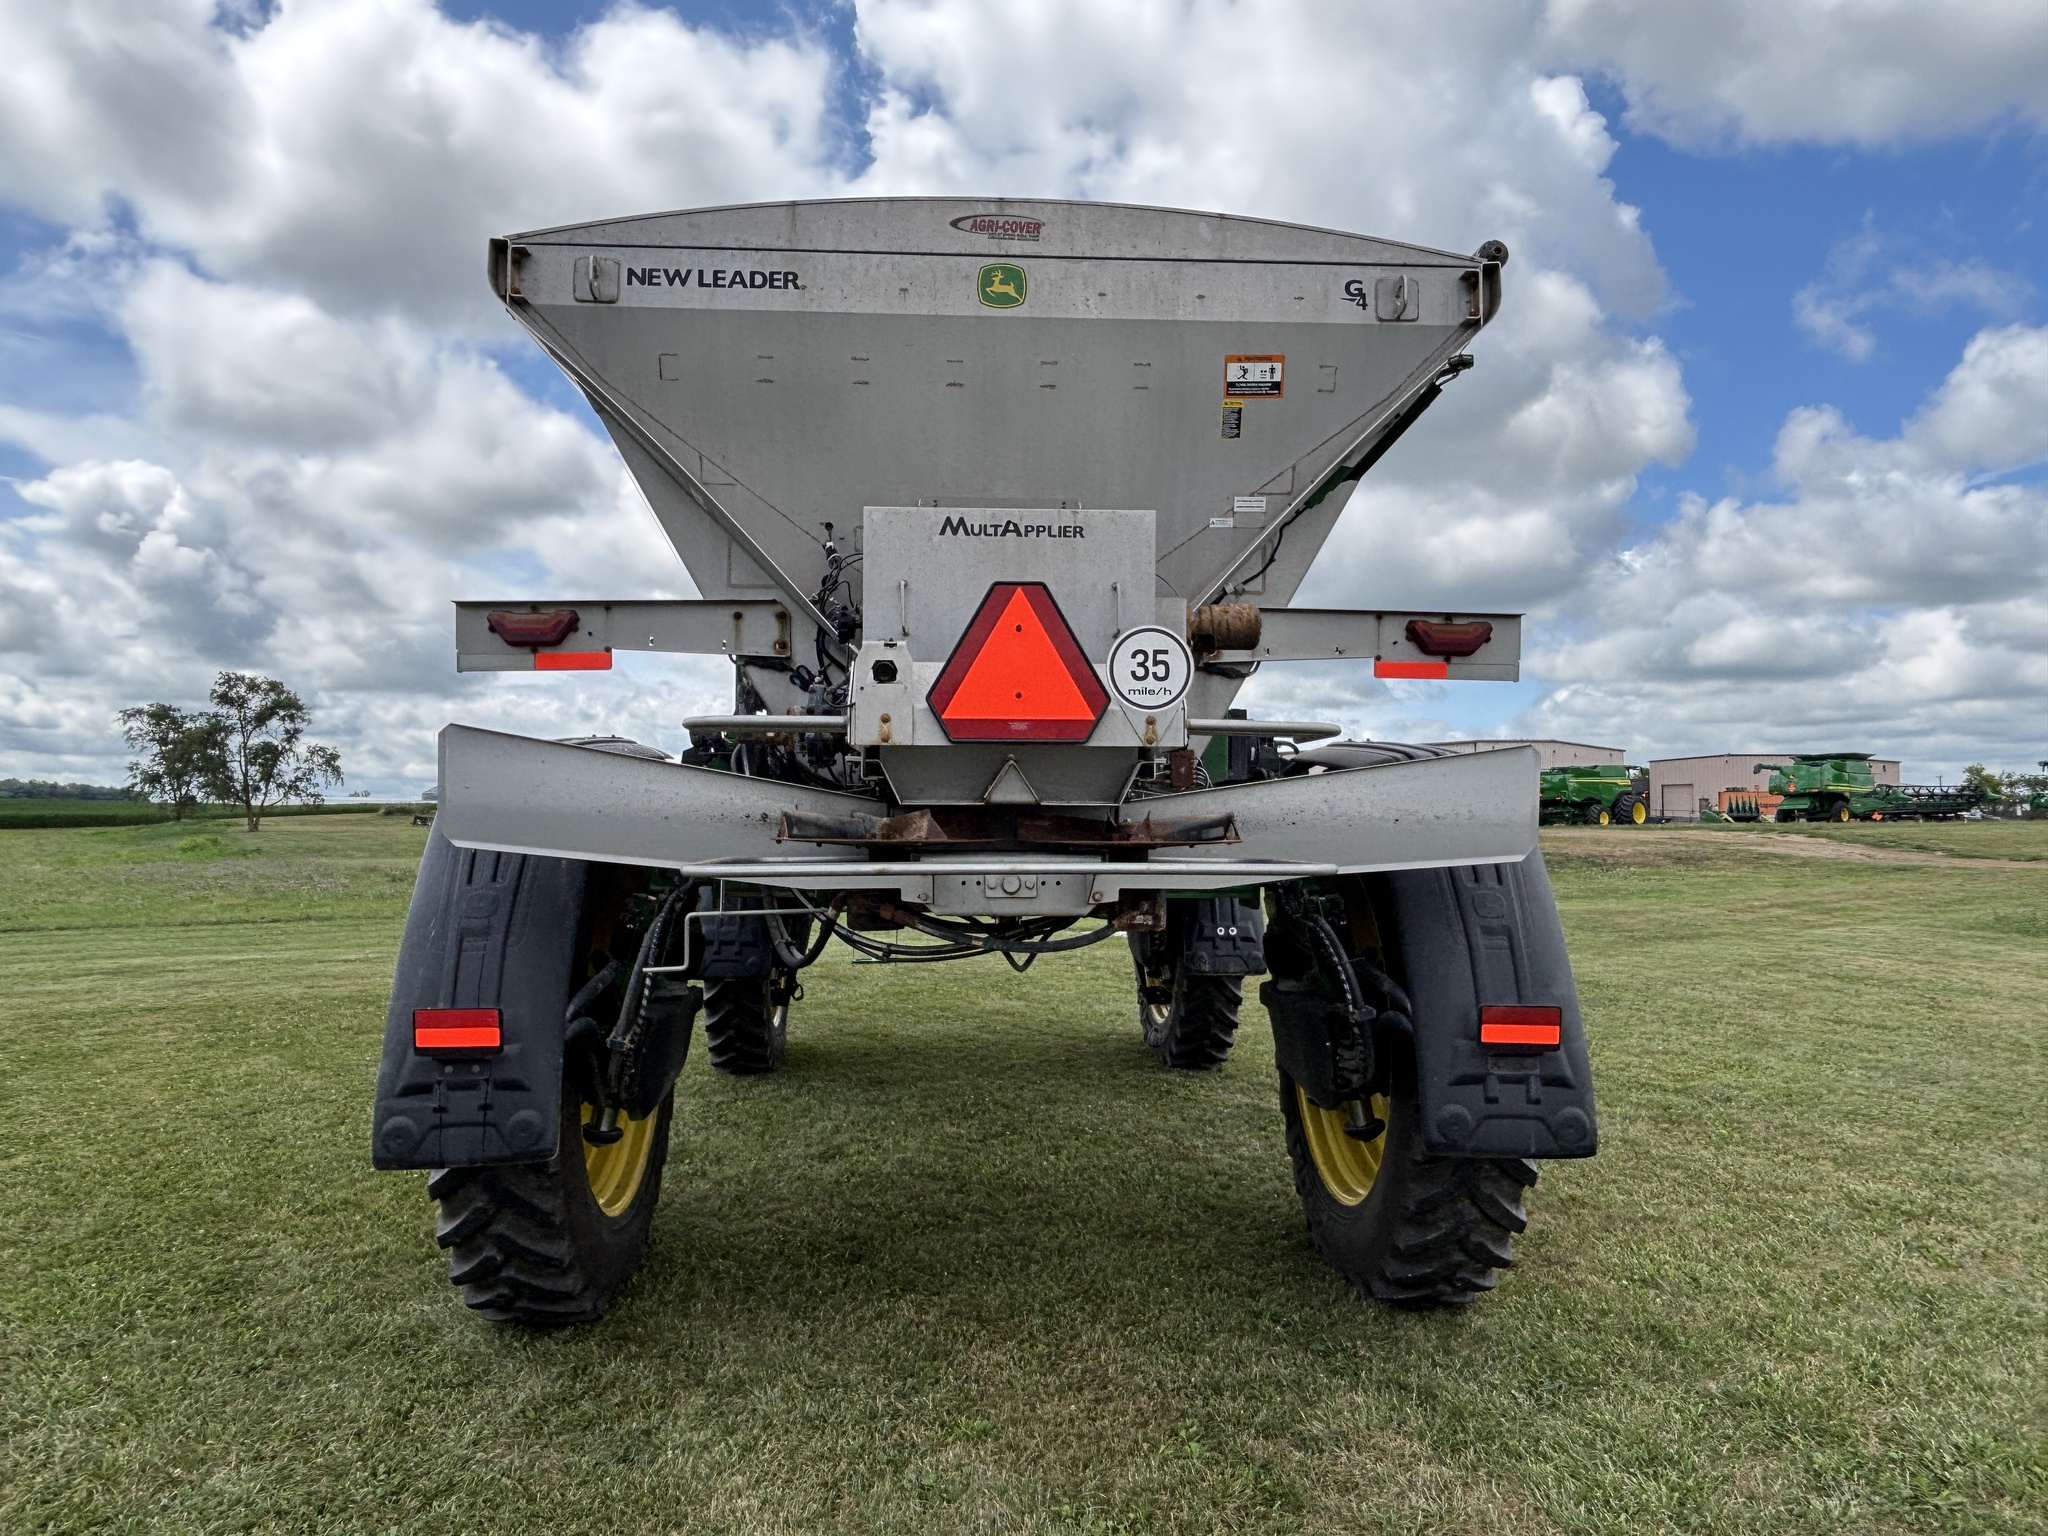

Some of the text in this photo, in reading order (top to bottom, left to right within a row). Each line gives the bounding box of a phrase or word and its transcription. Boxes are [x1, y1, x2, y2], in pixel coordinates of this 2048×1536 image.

[970, 219, 1041, 234] AGRI-COVER
[627, 268, 801, 290] NEW LEADER
[1130, 649, 1170, 682] 35
[1128, 687, 1172, 696] mile/h
